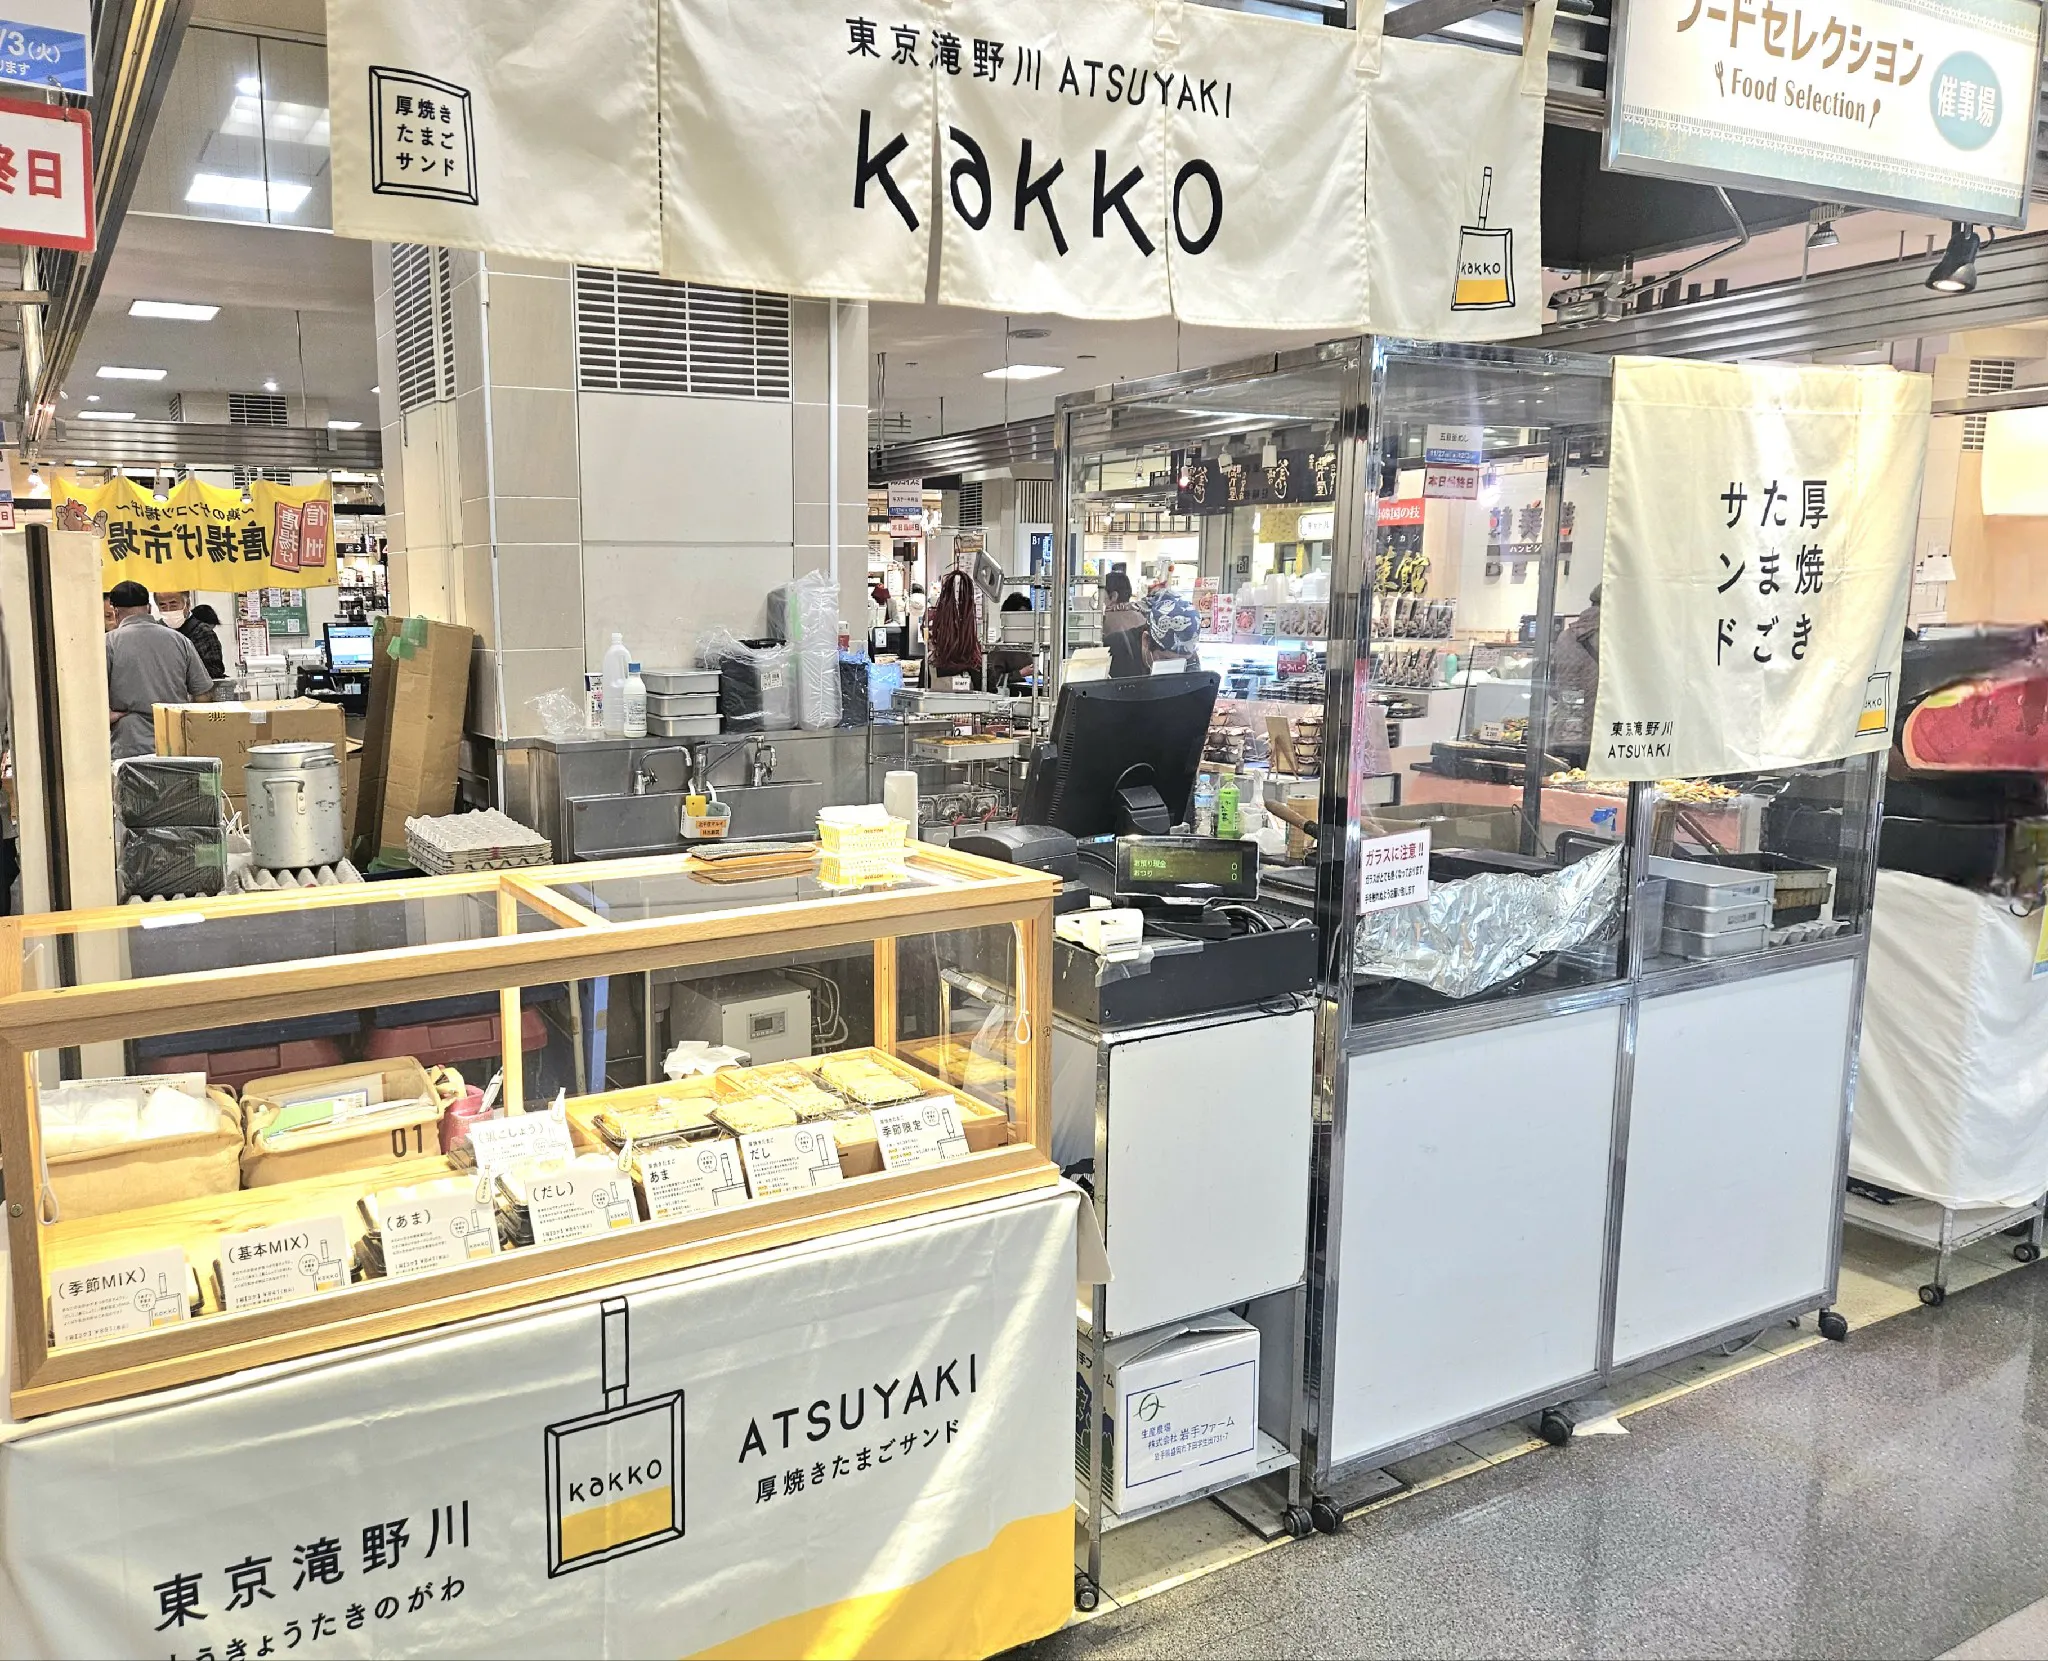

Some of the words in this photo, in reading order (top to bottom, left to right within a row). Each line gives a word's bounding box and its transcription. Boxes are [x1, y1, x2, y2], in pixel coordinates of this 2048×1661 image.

[845, 16, 1041, 91] 東京滝野川
[1058, 55, 1232, 119] ATSUYAKI
[395, 95, 452, 124] 厚焼き
[1731, 68, 1777, 103] Food
[1785, 80, 1866, 122] Selection
[1937, 74, 1997, 128] 催事場
[396, 123, 454, 150] たまご
[395, 152, 454, 177] サンド
[1717, 482, 1748, 666] サンド
[1753, 480, 1788, 664] たまご
[1791, 480, 1829, 661] 厚焼き
[1610, 720, 1673, 737] 東京滝野川
[1608, 743, 1672, 759] ATSUYAKI
[1231, 862, 1238, 870] 0
[391, 1123, 424, 1157] 01
[882, 1120, 922, 1138] 季節限定
[750, 1147, 770, 1160] だし
[533, 1181, 574, 1202] (だし)
[650, 1169, 670, 1183] あま
[387, 1209, 431, 1231] (あま)
[229, 1233, 309, 1263] (基本MIX)
[58, 1266, 146, 1299] (季節MIX)
[738, 1353, 976, 1463] ATSUYAKI
[1148, 1433, 1178, 1450] 株式会社
[1180, 1416, 1235, 1441] 岩手ファーム
[755, 1419, 960, 1504] 厚焼きたまごサンド
[153, 1500, 470, 1632] 東京滝野川
[168, 1575, 465, 1661] うきょうたきのがわ
